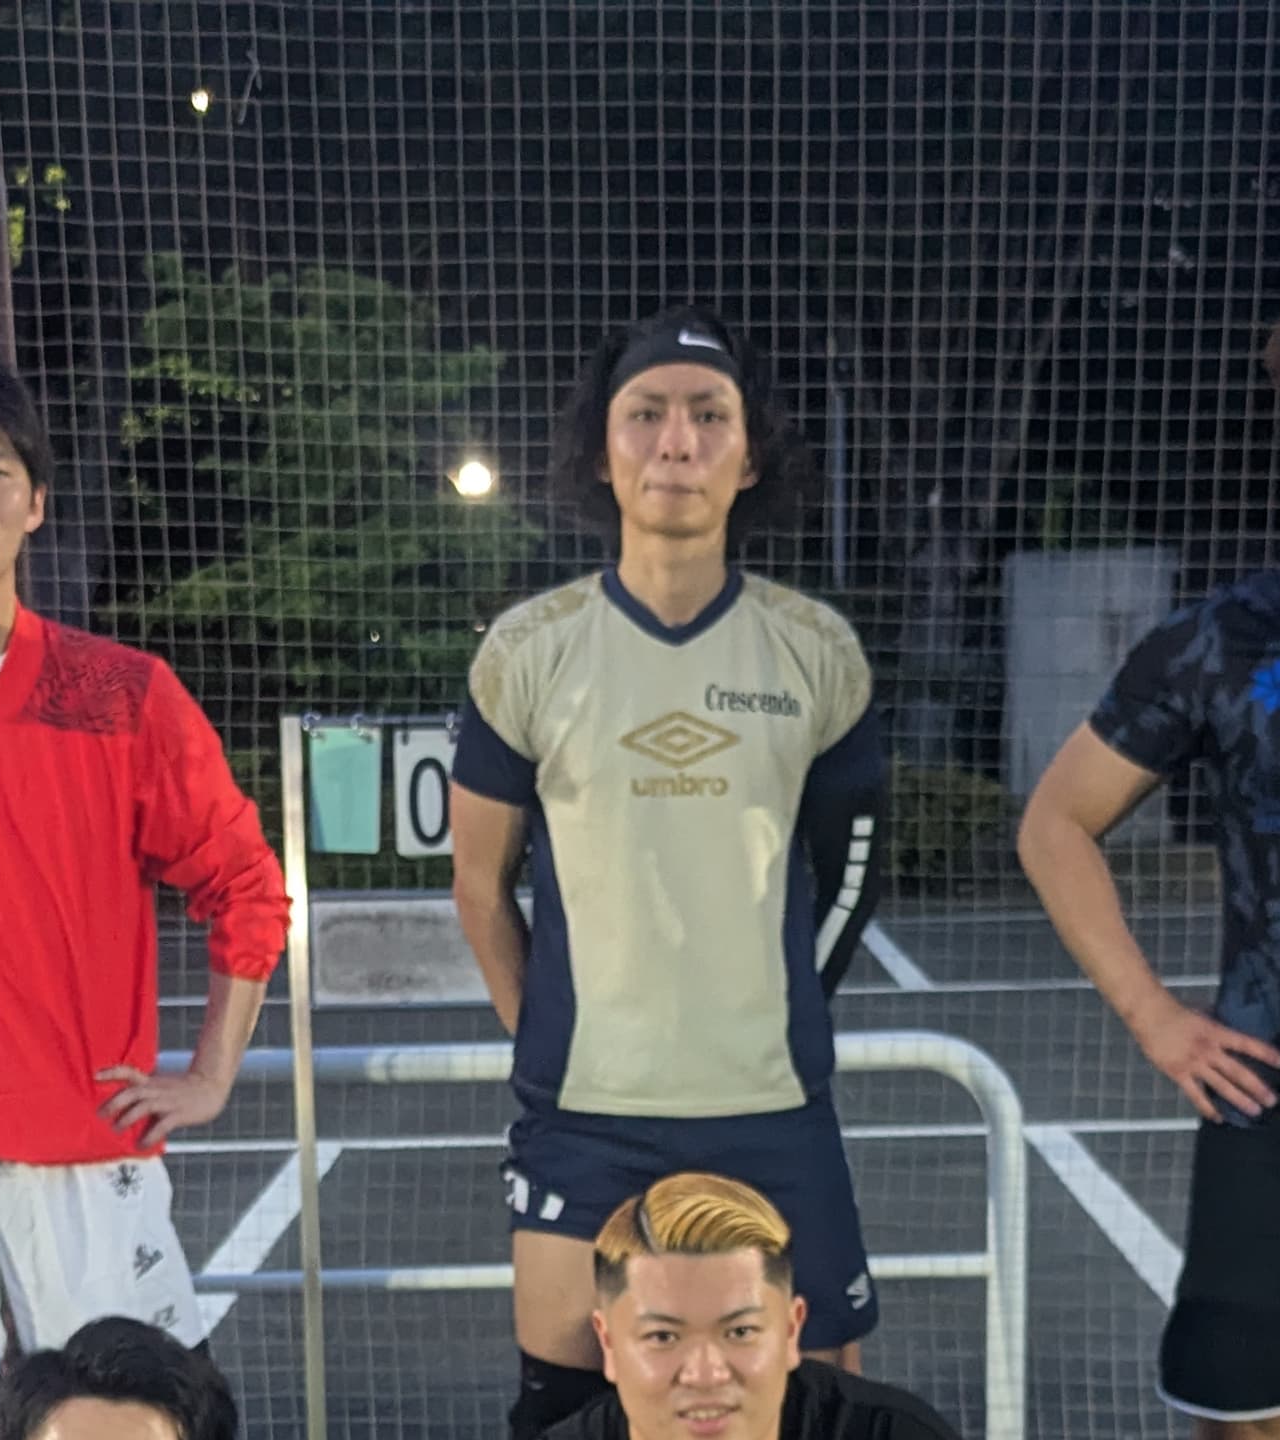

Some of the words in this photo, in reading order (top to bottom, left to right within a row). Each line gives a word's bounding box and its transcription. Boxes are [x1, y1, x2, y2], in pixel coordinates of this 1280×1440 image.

[704, 684, 802, 718] Crescendo
[631, 772, 729, 796] umbro
[409, 757, 450, 847] 0
